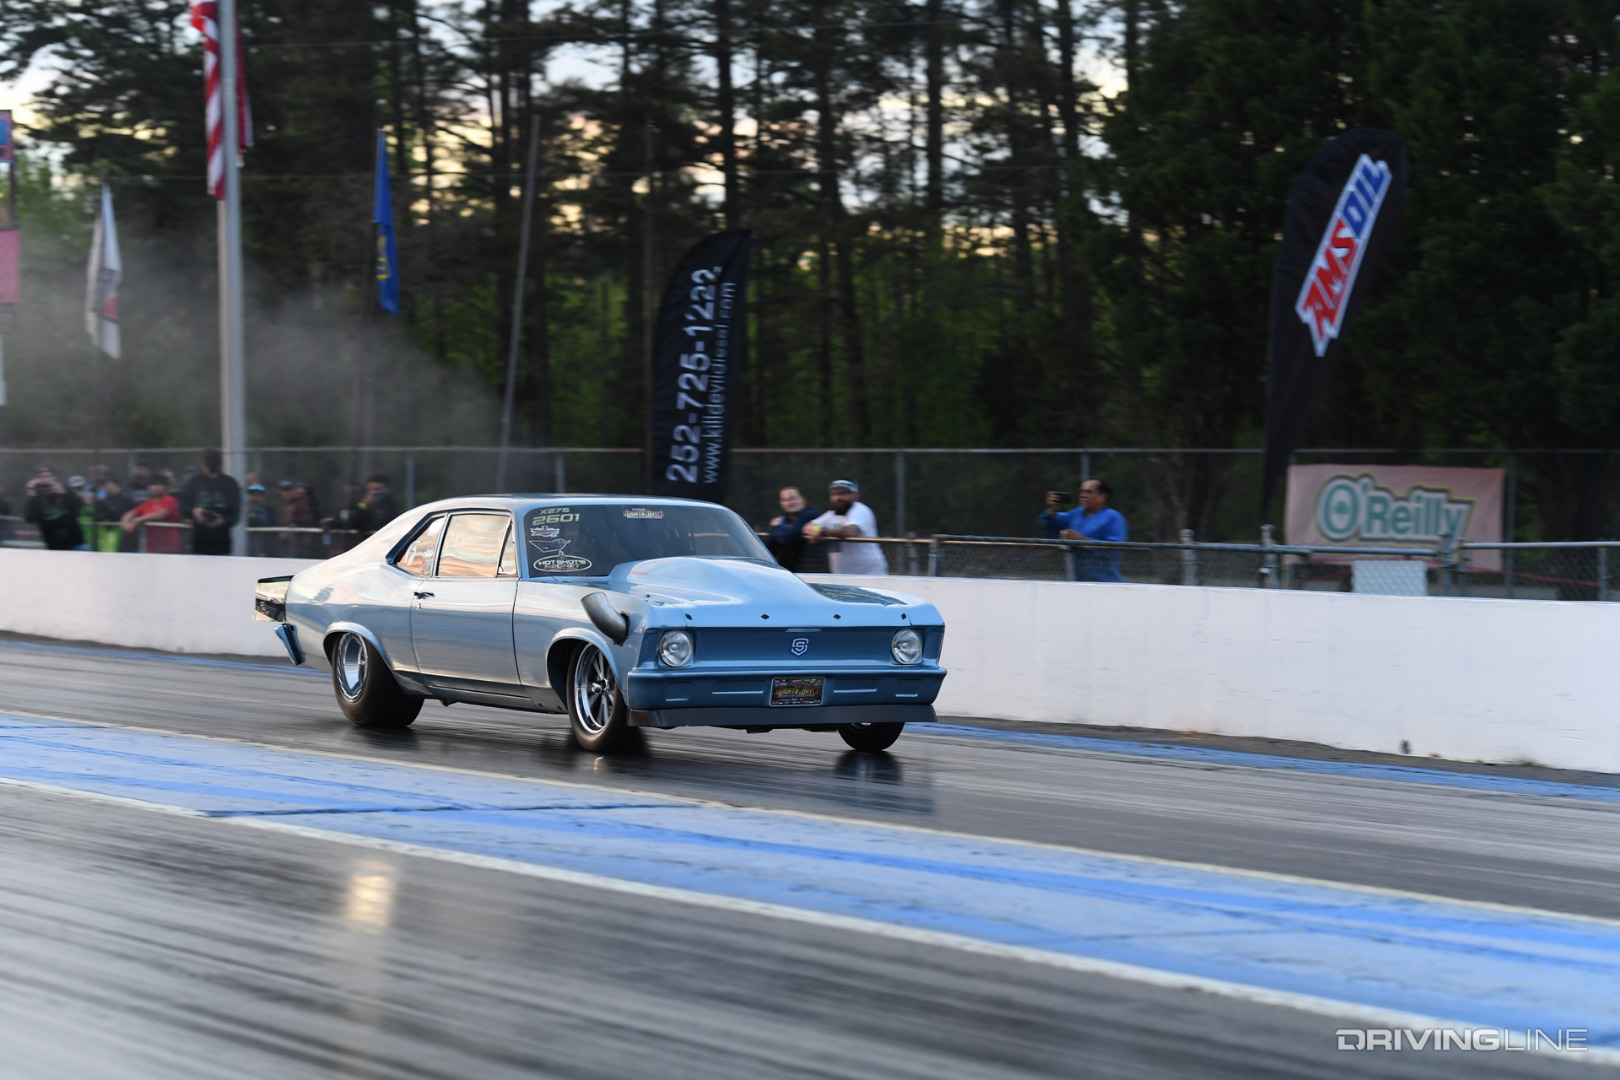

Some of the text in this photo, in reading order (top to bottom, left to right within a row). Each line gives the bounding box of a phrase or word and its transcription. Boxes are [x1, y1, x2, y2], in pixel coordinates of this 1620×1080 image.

[1299, 160, 1389, 345] AMSOIL
[532, 513, 580, 526] 2601
[540, 507, 570, 515] X275
[1322, 480, 1467, 546] O'Reilly
